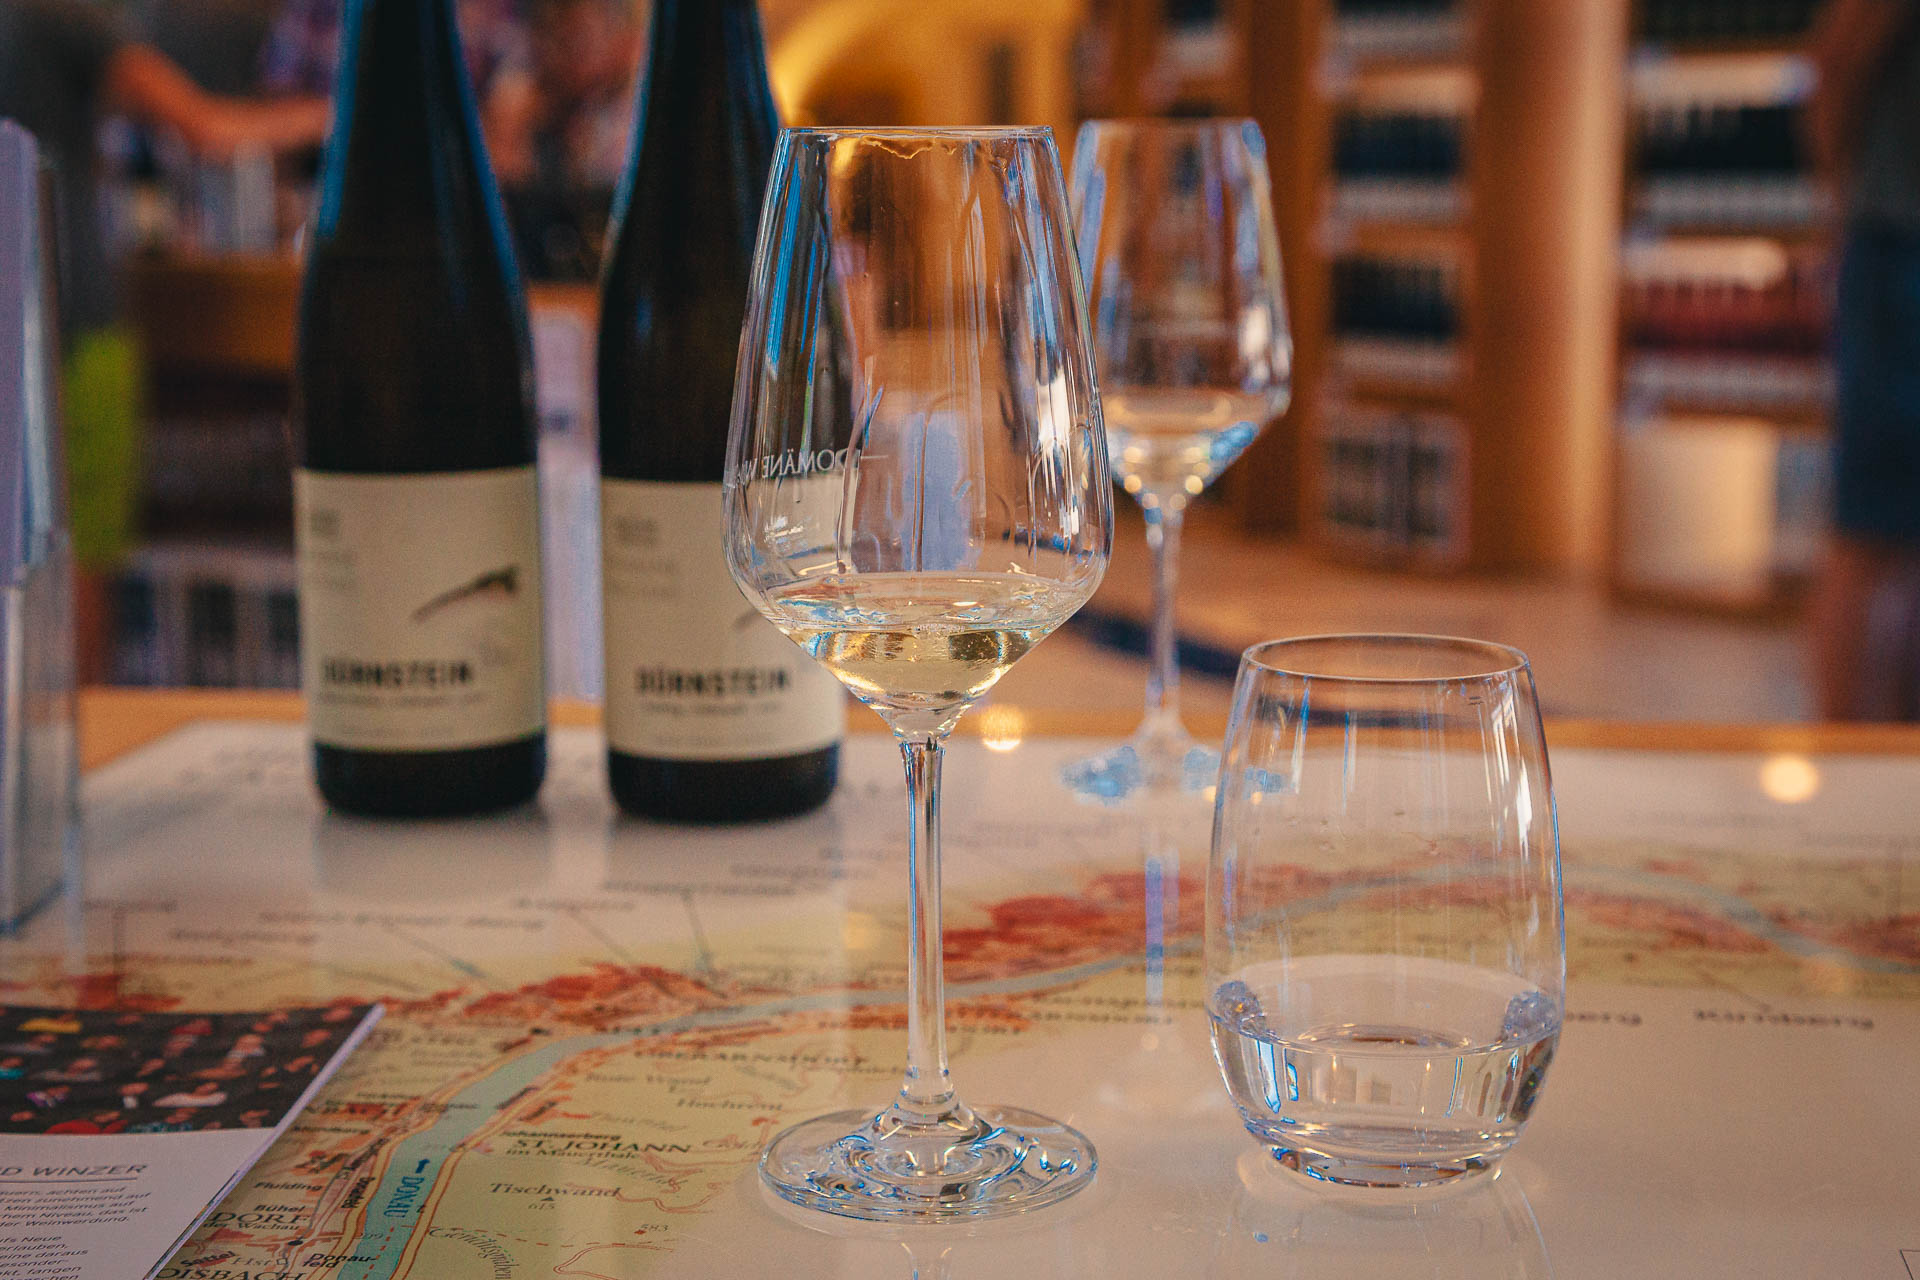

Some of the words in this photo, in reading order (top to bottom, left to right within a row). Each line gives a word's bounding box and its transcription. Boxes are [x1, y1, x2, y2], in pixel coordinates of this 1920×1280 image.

[564, 1140, 691, 1154] JOHANN
[33, 1164, 148, 1176] WINZER
[490, 1183, 622, 1198] Tischwand
[384, 1176, 424, 1218] DONAU
[4, 1202, 105, 1211] Minimalismus
[21, 1235, 62, 1243] Neue
[35, 1249, 89, 1259] daraus
[310, 1252, 379, 1263] Donau-
[27, 1266, 82, 1275] fangen
